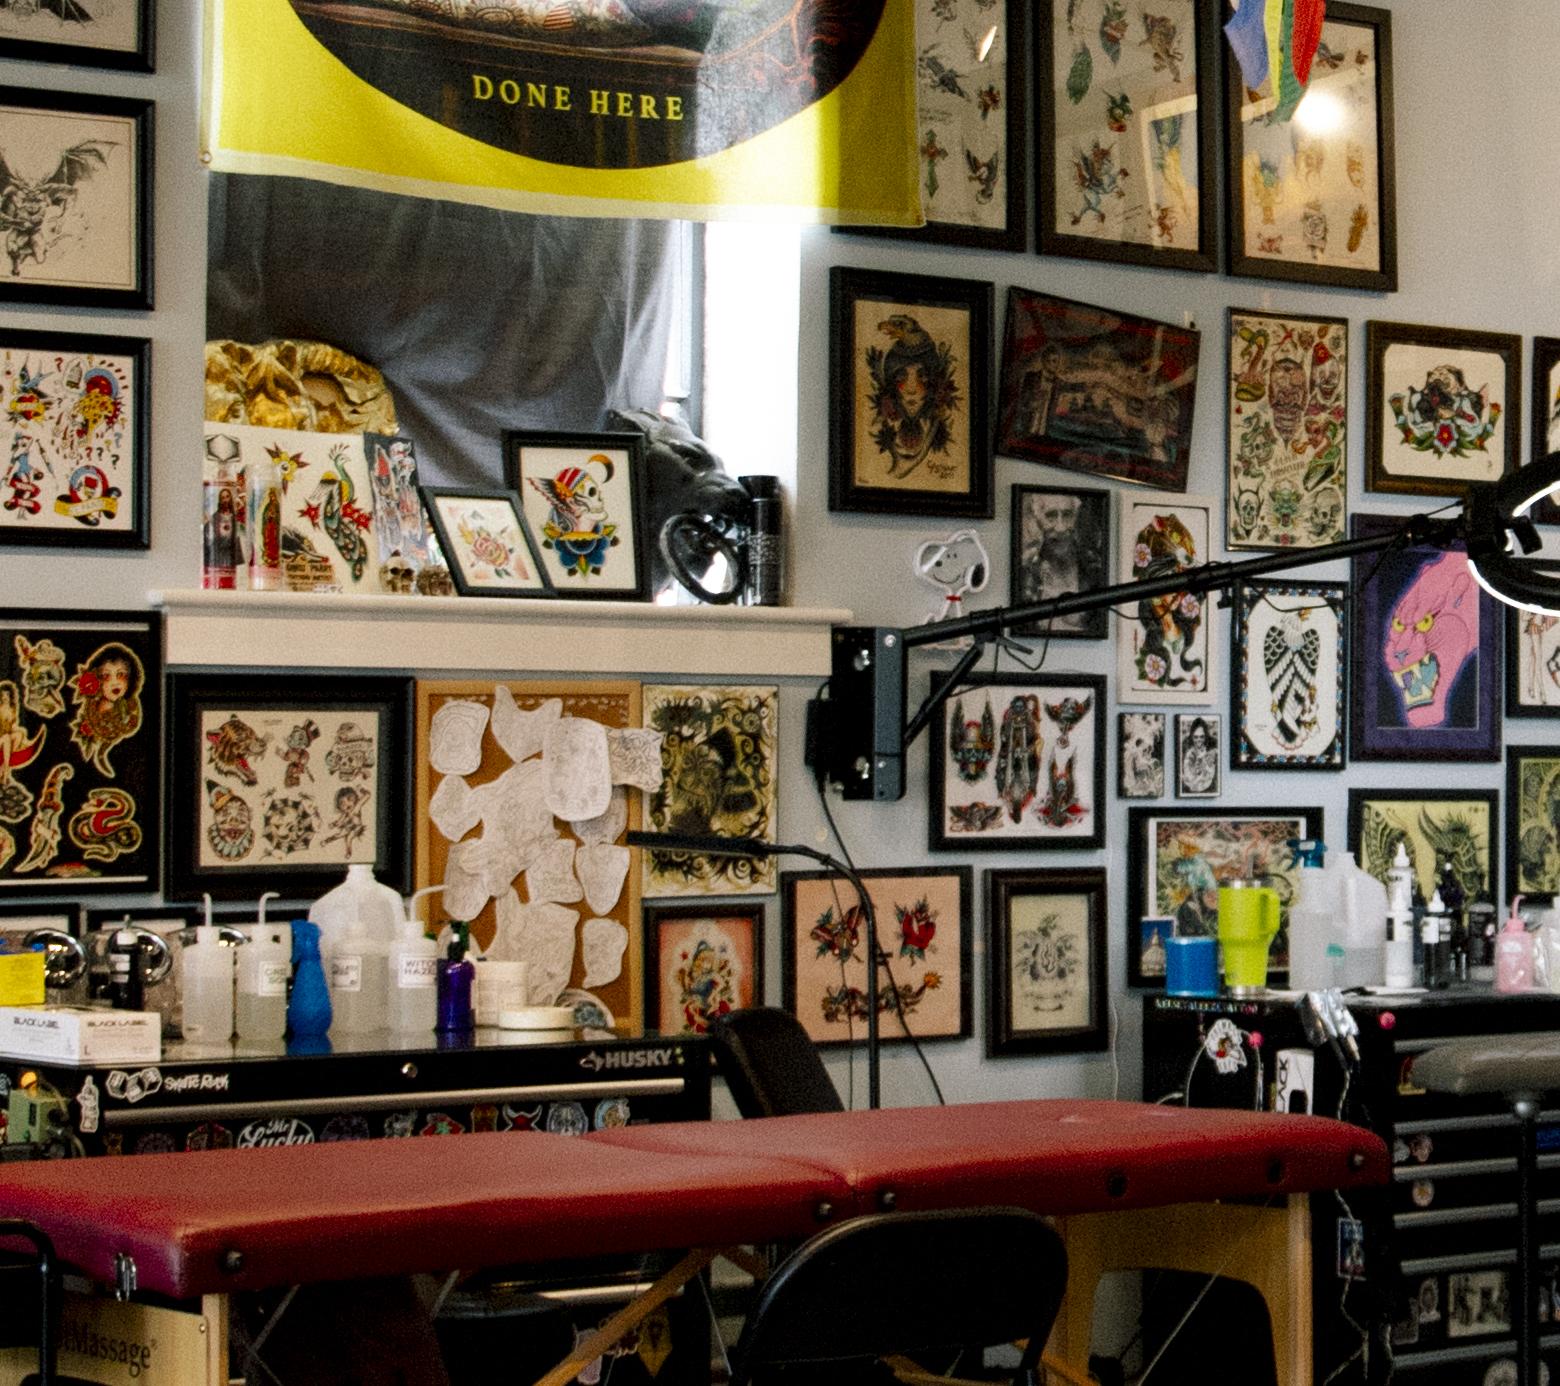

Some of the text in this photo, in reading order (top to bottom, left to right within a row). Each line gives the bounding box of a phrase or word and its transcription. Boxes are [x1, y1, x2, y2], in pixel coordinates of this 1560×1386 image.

[472, 74, 684, 121] DONE HERE
[404, 967, 436, 975] HAZE
[605, 1049, 672, 1069] HUSKY
[239, 1119, 313, 1148] Lucky
